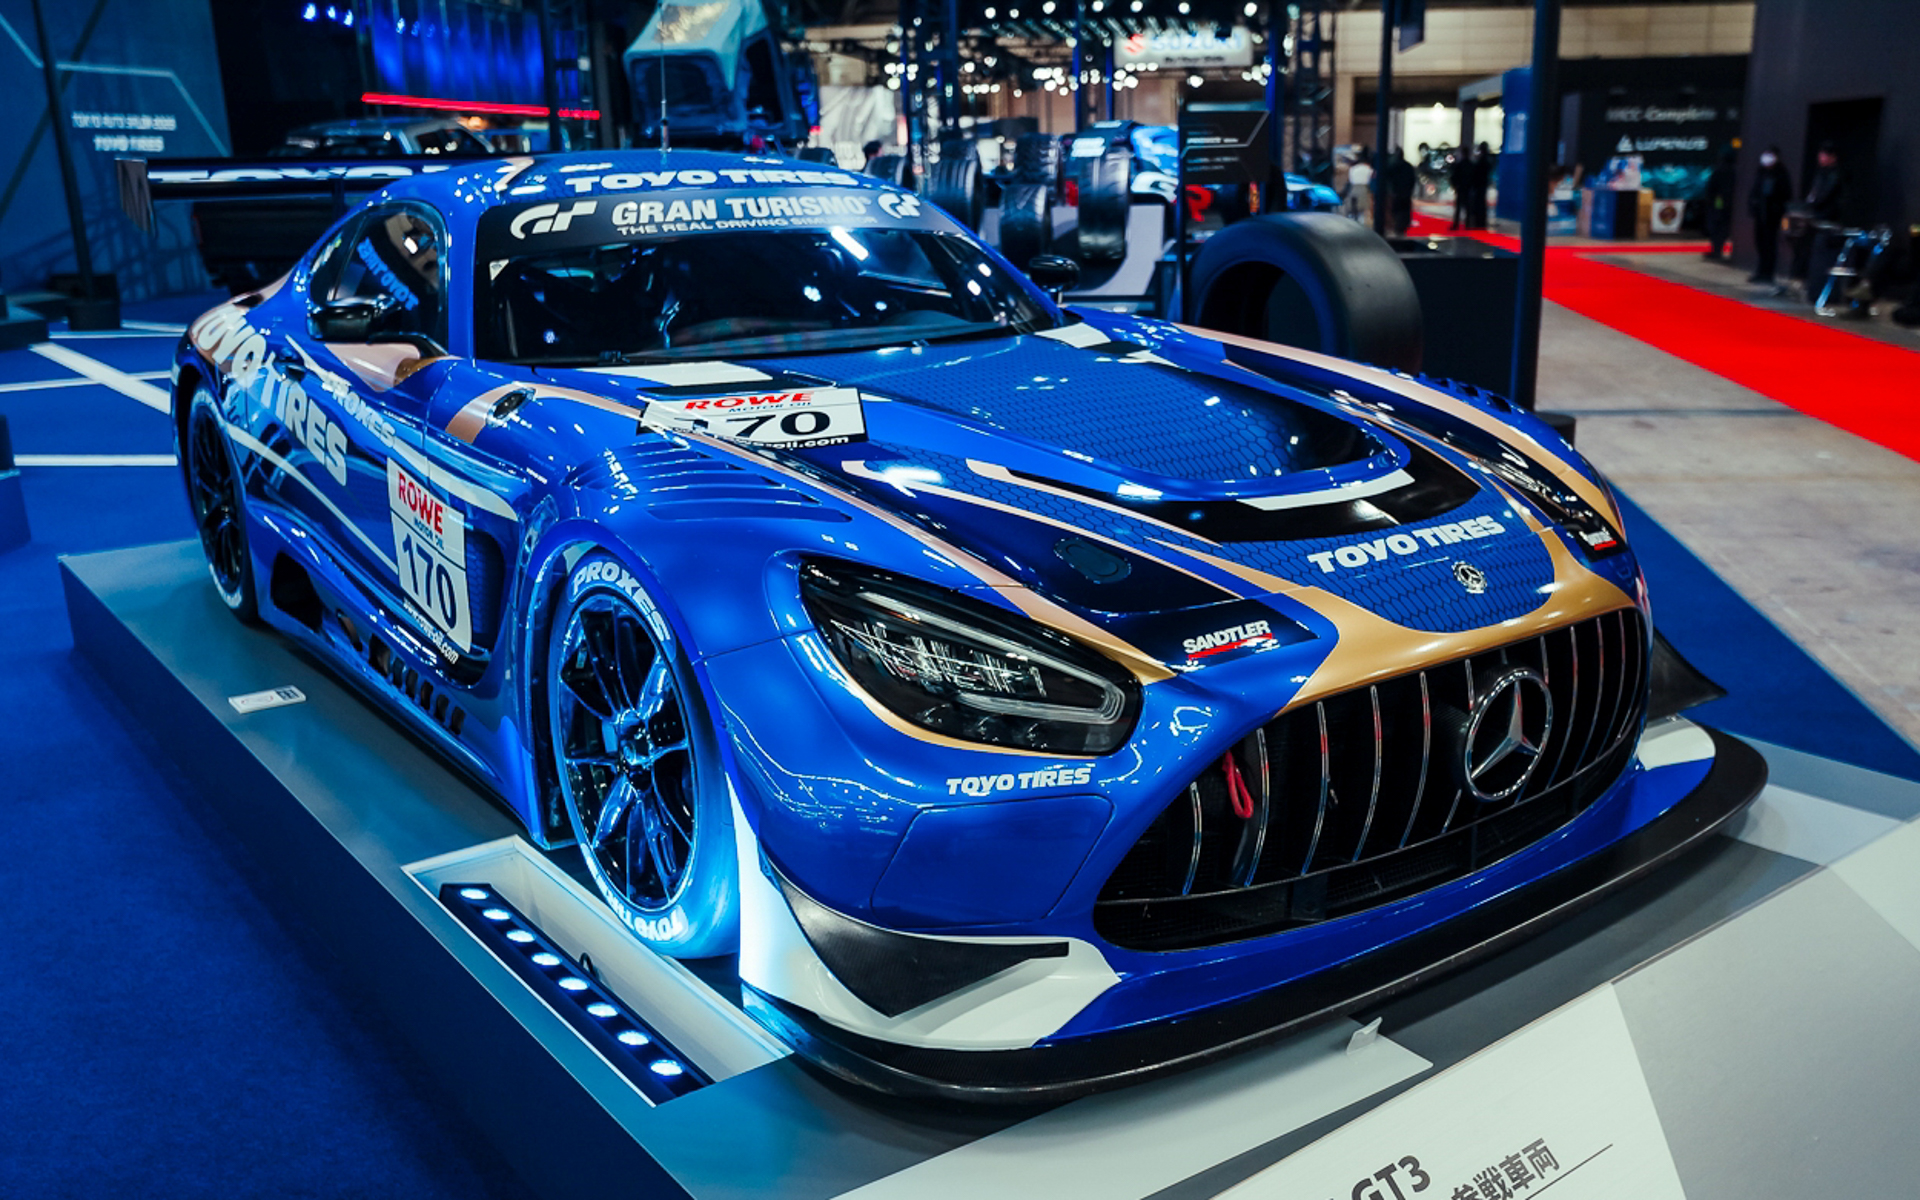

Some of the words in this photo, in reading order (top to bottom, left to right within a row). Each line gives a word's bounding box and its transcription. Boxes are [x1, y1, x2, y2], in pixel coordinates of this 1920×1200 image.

[565, 170, 714, 193] TOYO
[718, 168, 859, 187] TIRES
[612, 200, 717, 226] GRAN
[617, 224, 659, 236] THE
[661, 222, 713, 234] REAL
[715, 218, 789, 229] DRIVING
[258, 350, 348, 487] TIRES
[684, 392, 814, 411] ROWE
[397, 471, 444, 535] ROWE
[1307, 533, 1420, 573] TOYO
[1411, 515, 1506, 548] TIRES
[402, 532, 457, 630] 170
[572, 561, 671, 642] PROXES
[1182, 620, 1272, 654] SANDTLER
[946, 773, 1015, 797] TOYO
[1017, 767, 1092, 790] TIRES
[634, 903, 690, 942] TOYO
